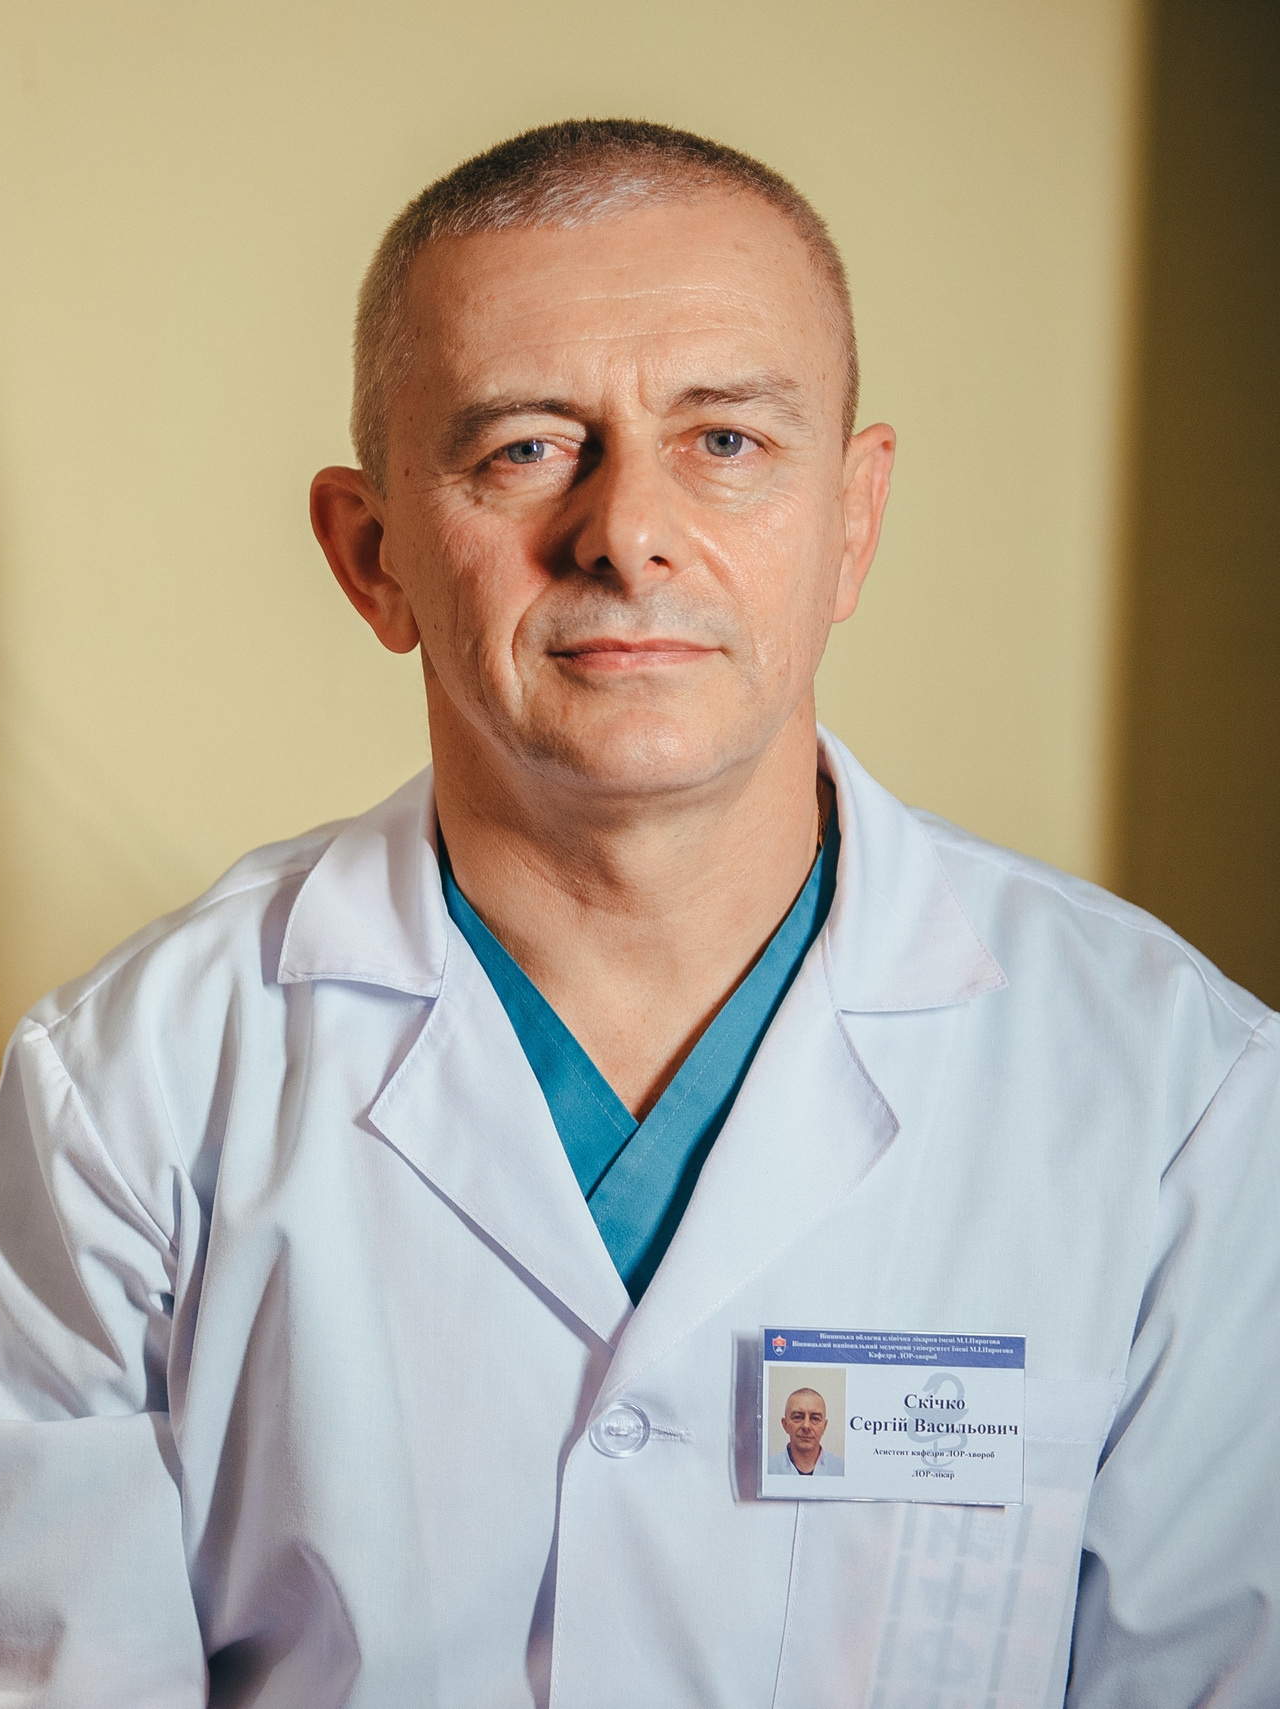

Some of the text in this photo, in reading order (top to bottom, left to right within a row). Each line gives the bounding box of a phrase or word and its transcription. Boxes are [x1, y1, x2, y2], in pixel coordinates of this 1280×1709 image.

[903, 1393, 966, 1410] Скічко
[849, 1415, 1019, 1436] Сергій Васильович
[873, 1448, 996, 1460] Асистент кафедри ЛОР-хвороб
[911, 1470, 956, 1481] ЛОР-лікар
